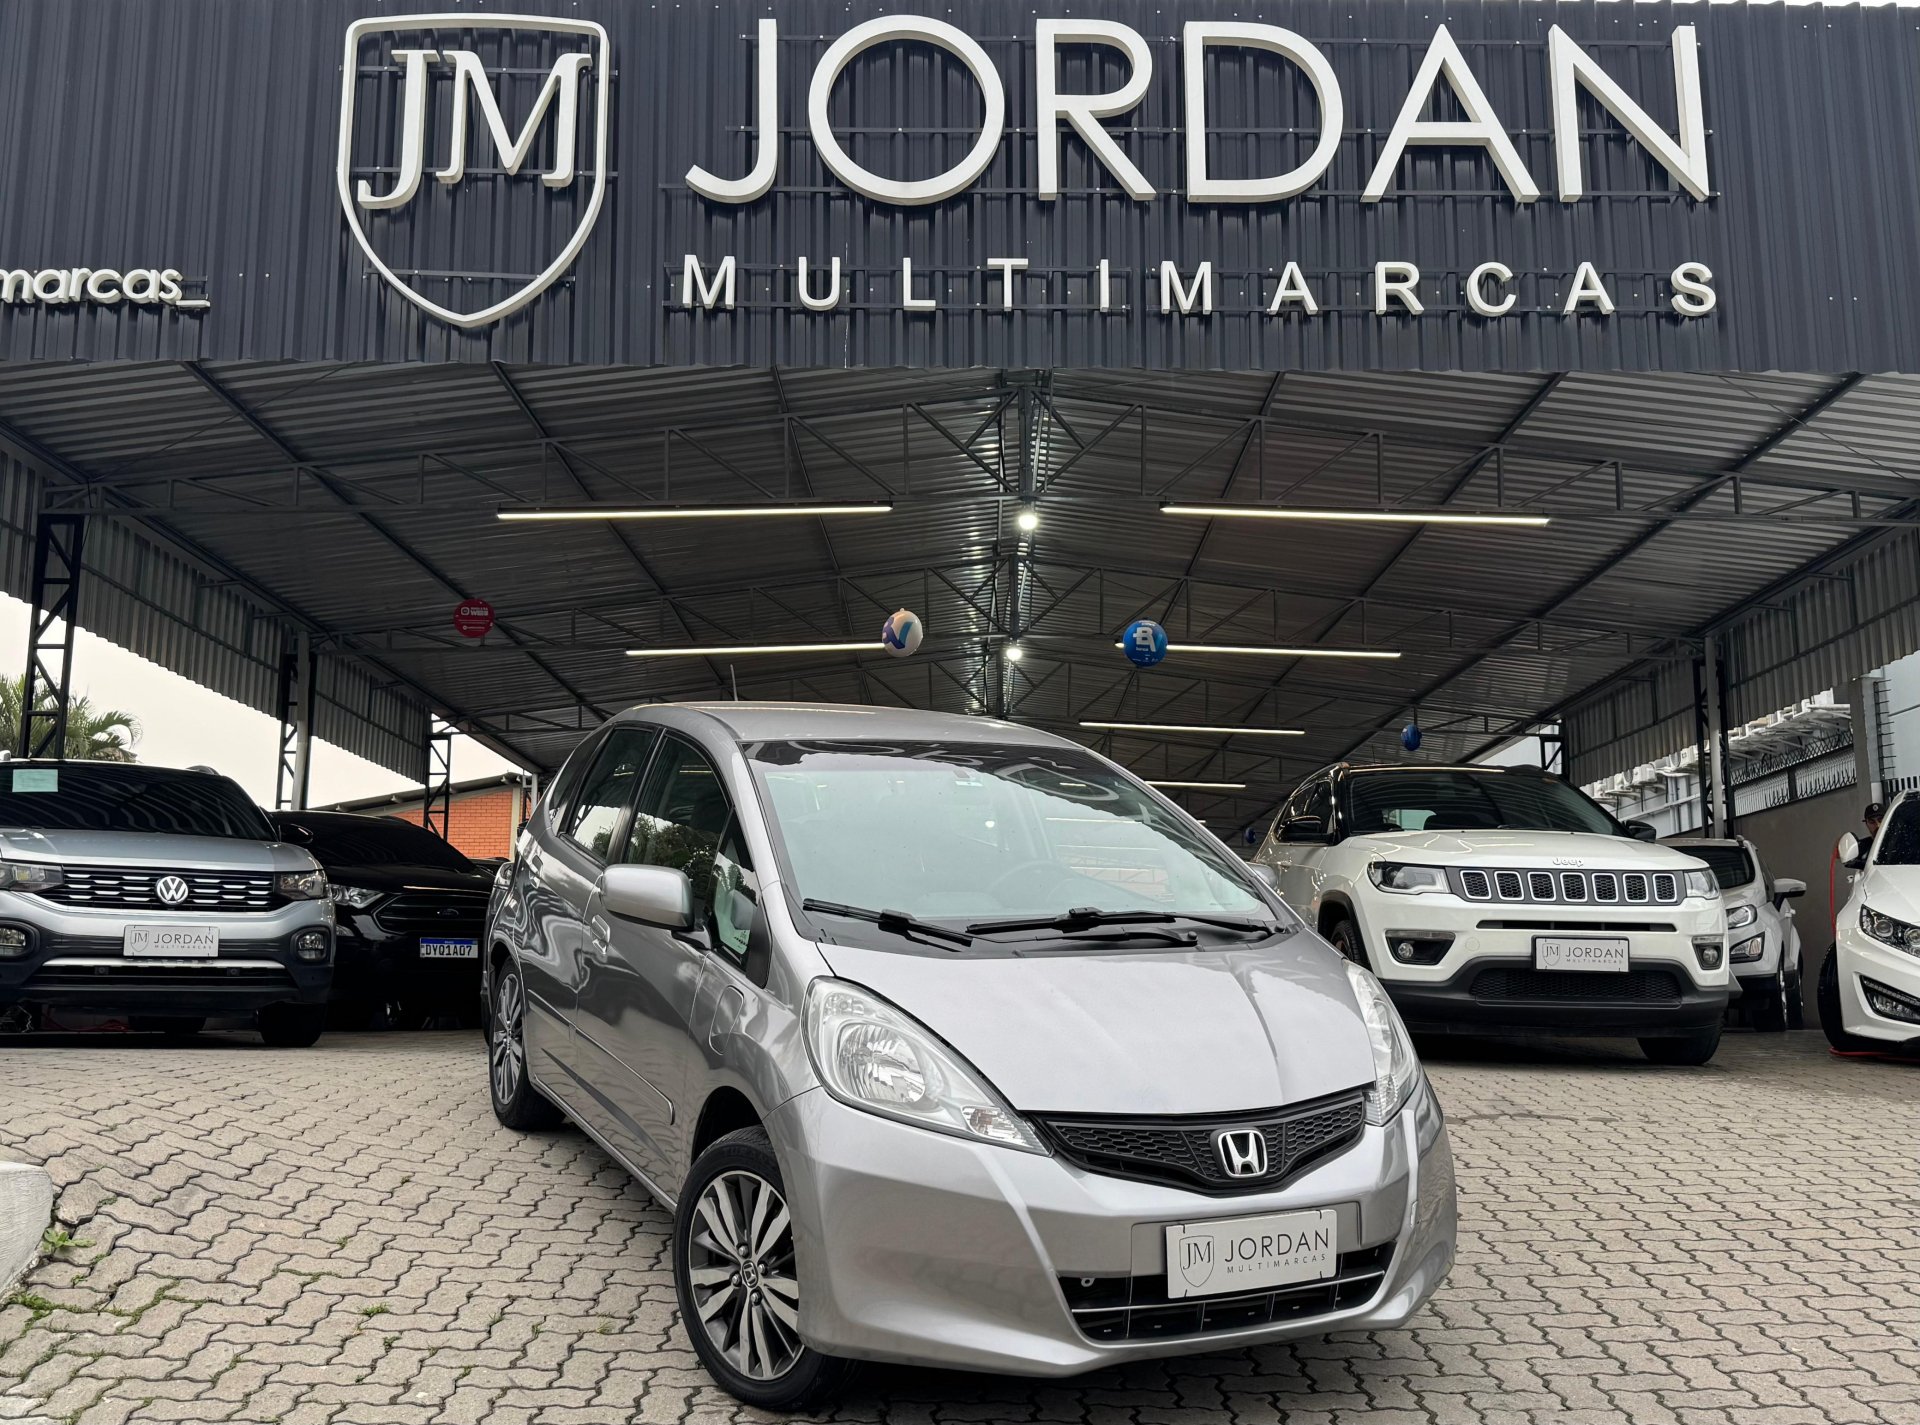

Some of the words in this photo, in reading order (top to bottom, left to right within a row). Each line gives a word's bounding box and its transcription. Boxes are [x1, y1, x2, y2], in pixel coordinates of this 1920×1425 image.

[685, 14, 1709, 205] JORDAN
[358, 49, 592, 210] JM
[683, 254, 1716, 318] MULTIMARCAS
[1552, 857, 1584, 868] Jeep
[154, 933, 214, 945] JORDAN
[425, 944, 472, 957] DYQ1A07
[1565, 946, 1624, 959] JORDAN
[1183, 1240, 1212, 1270] JM
[1225, 1228, 1329, 1263] JORDAN
[1227, 1253, 1326, 1274] MULTIMARCAS
